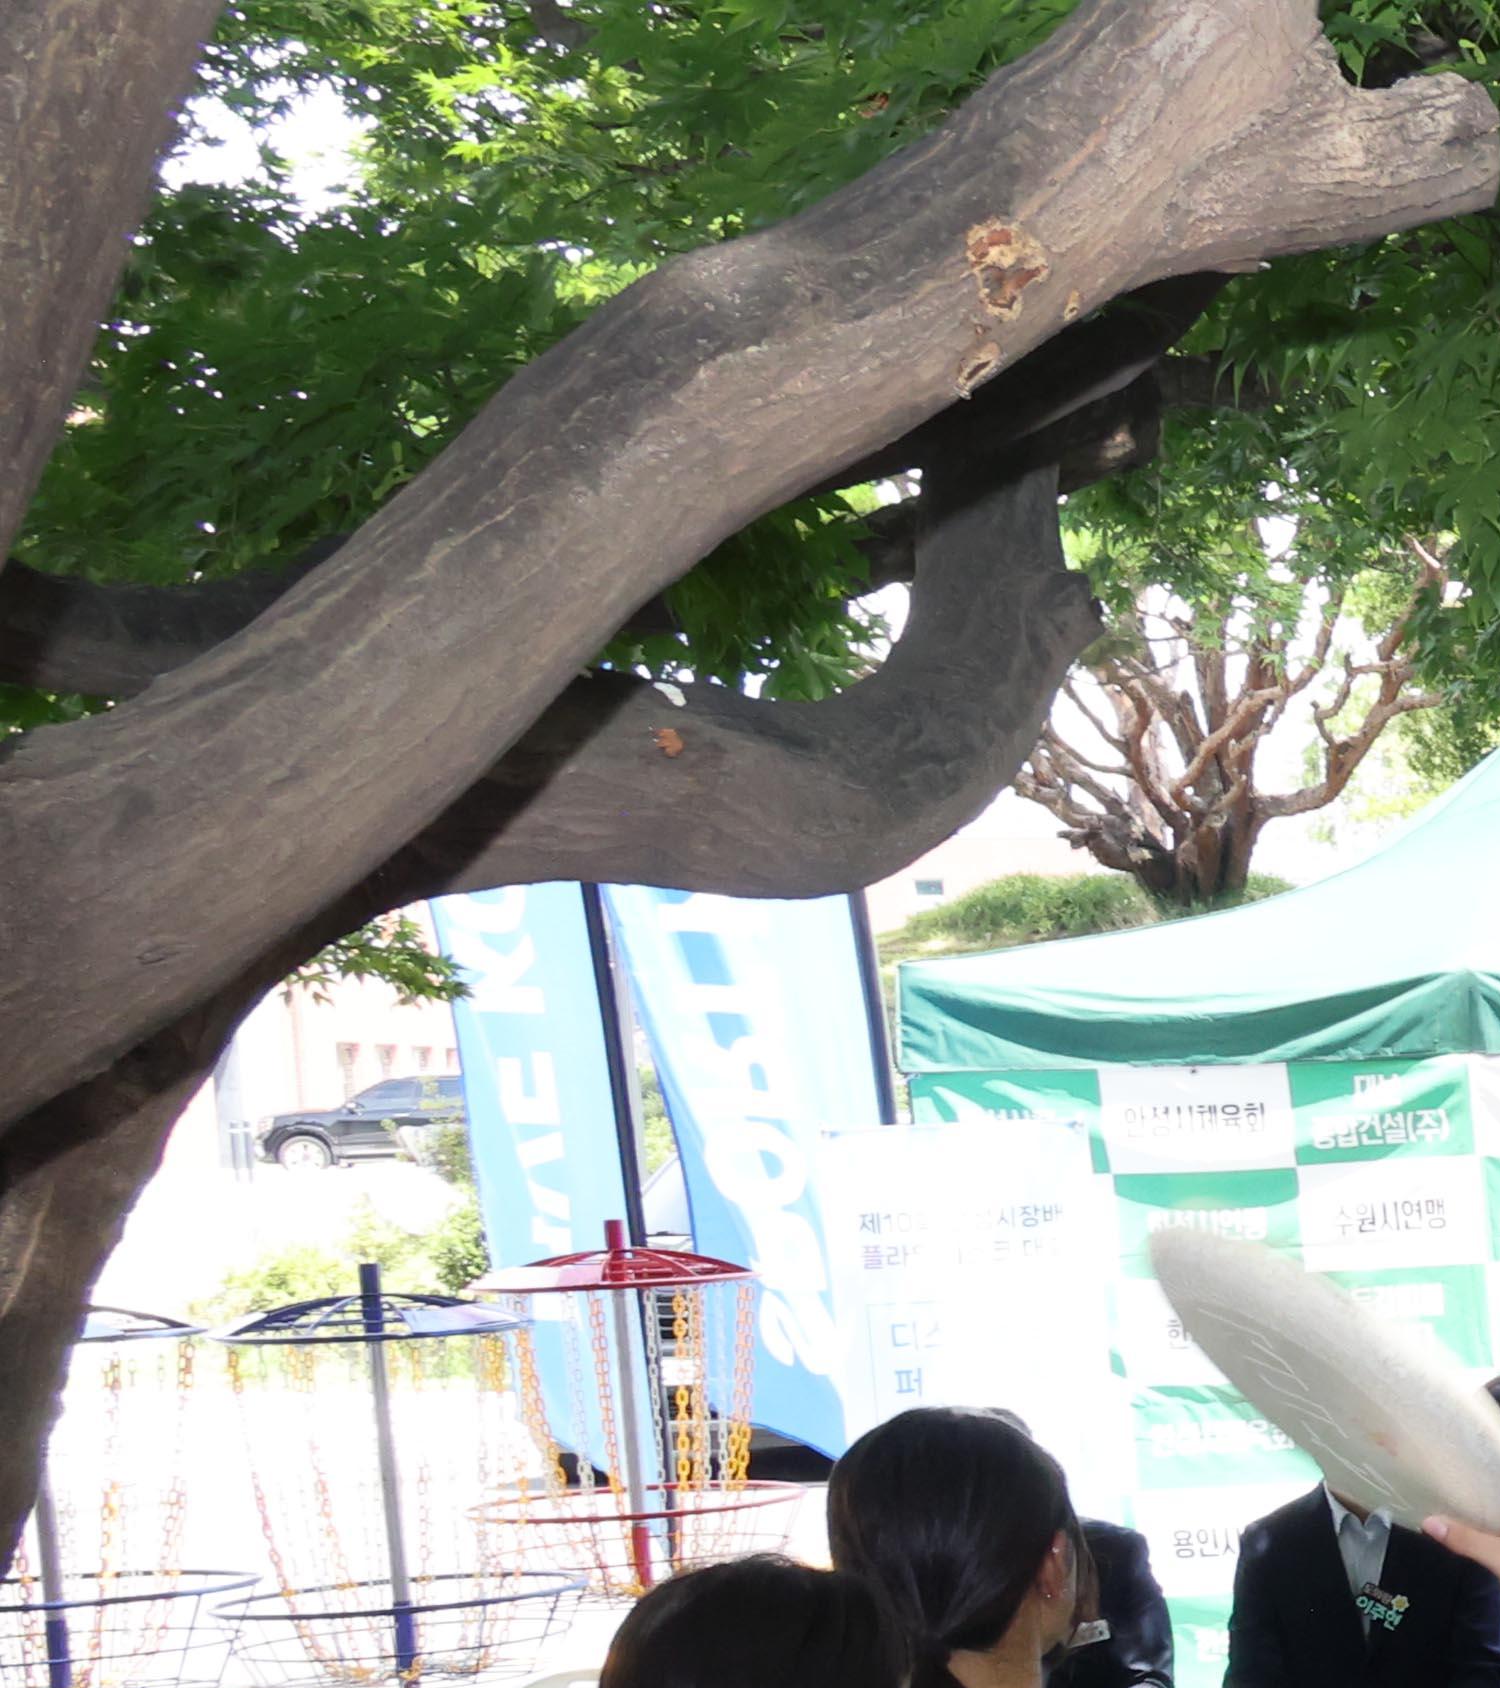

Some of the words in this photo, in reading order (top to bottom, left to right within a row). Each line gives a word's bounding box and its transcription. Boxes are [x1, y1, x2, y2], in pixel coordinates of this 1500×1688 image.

[1123, 1101, 1266, 1138] 안성시체육회
[1335, 1197, 1448, 1239] 수원시연맹
[1355, 1595, 1403, 1631] 이주현
